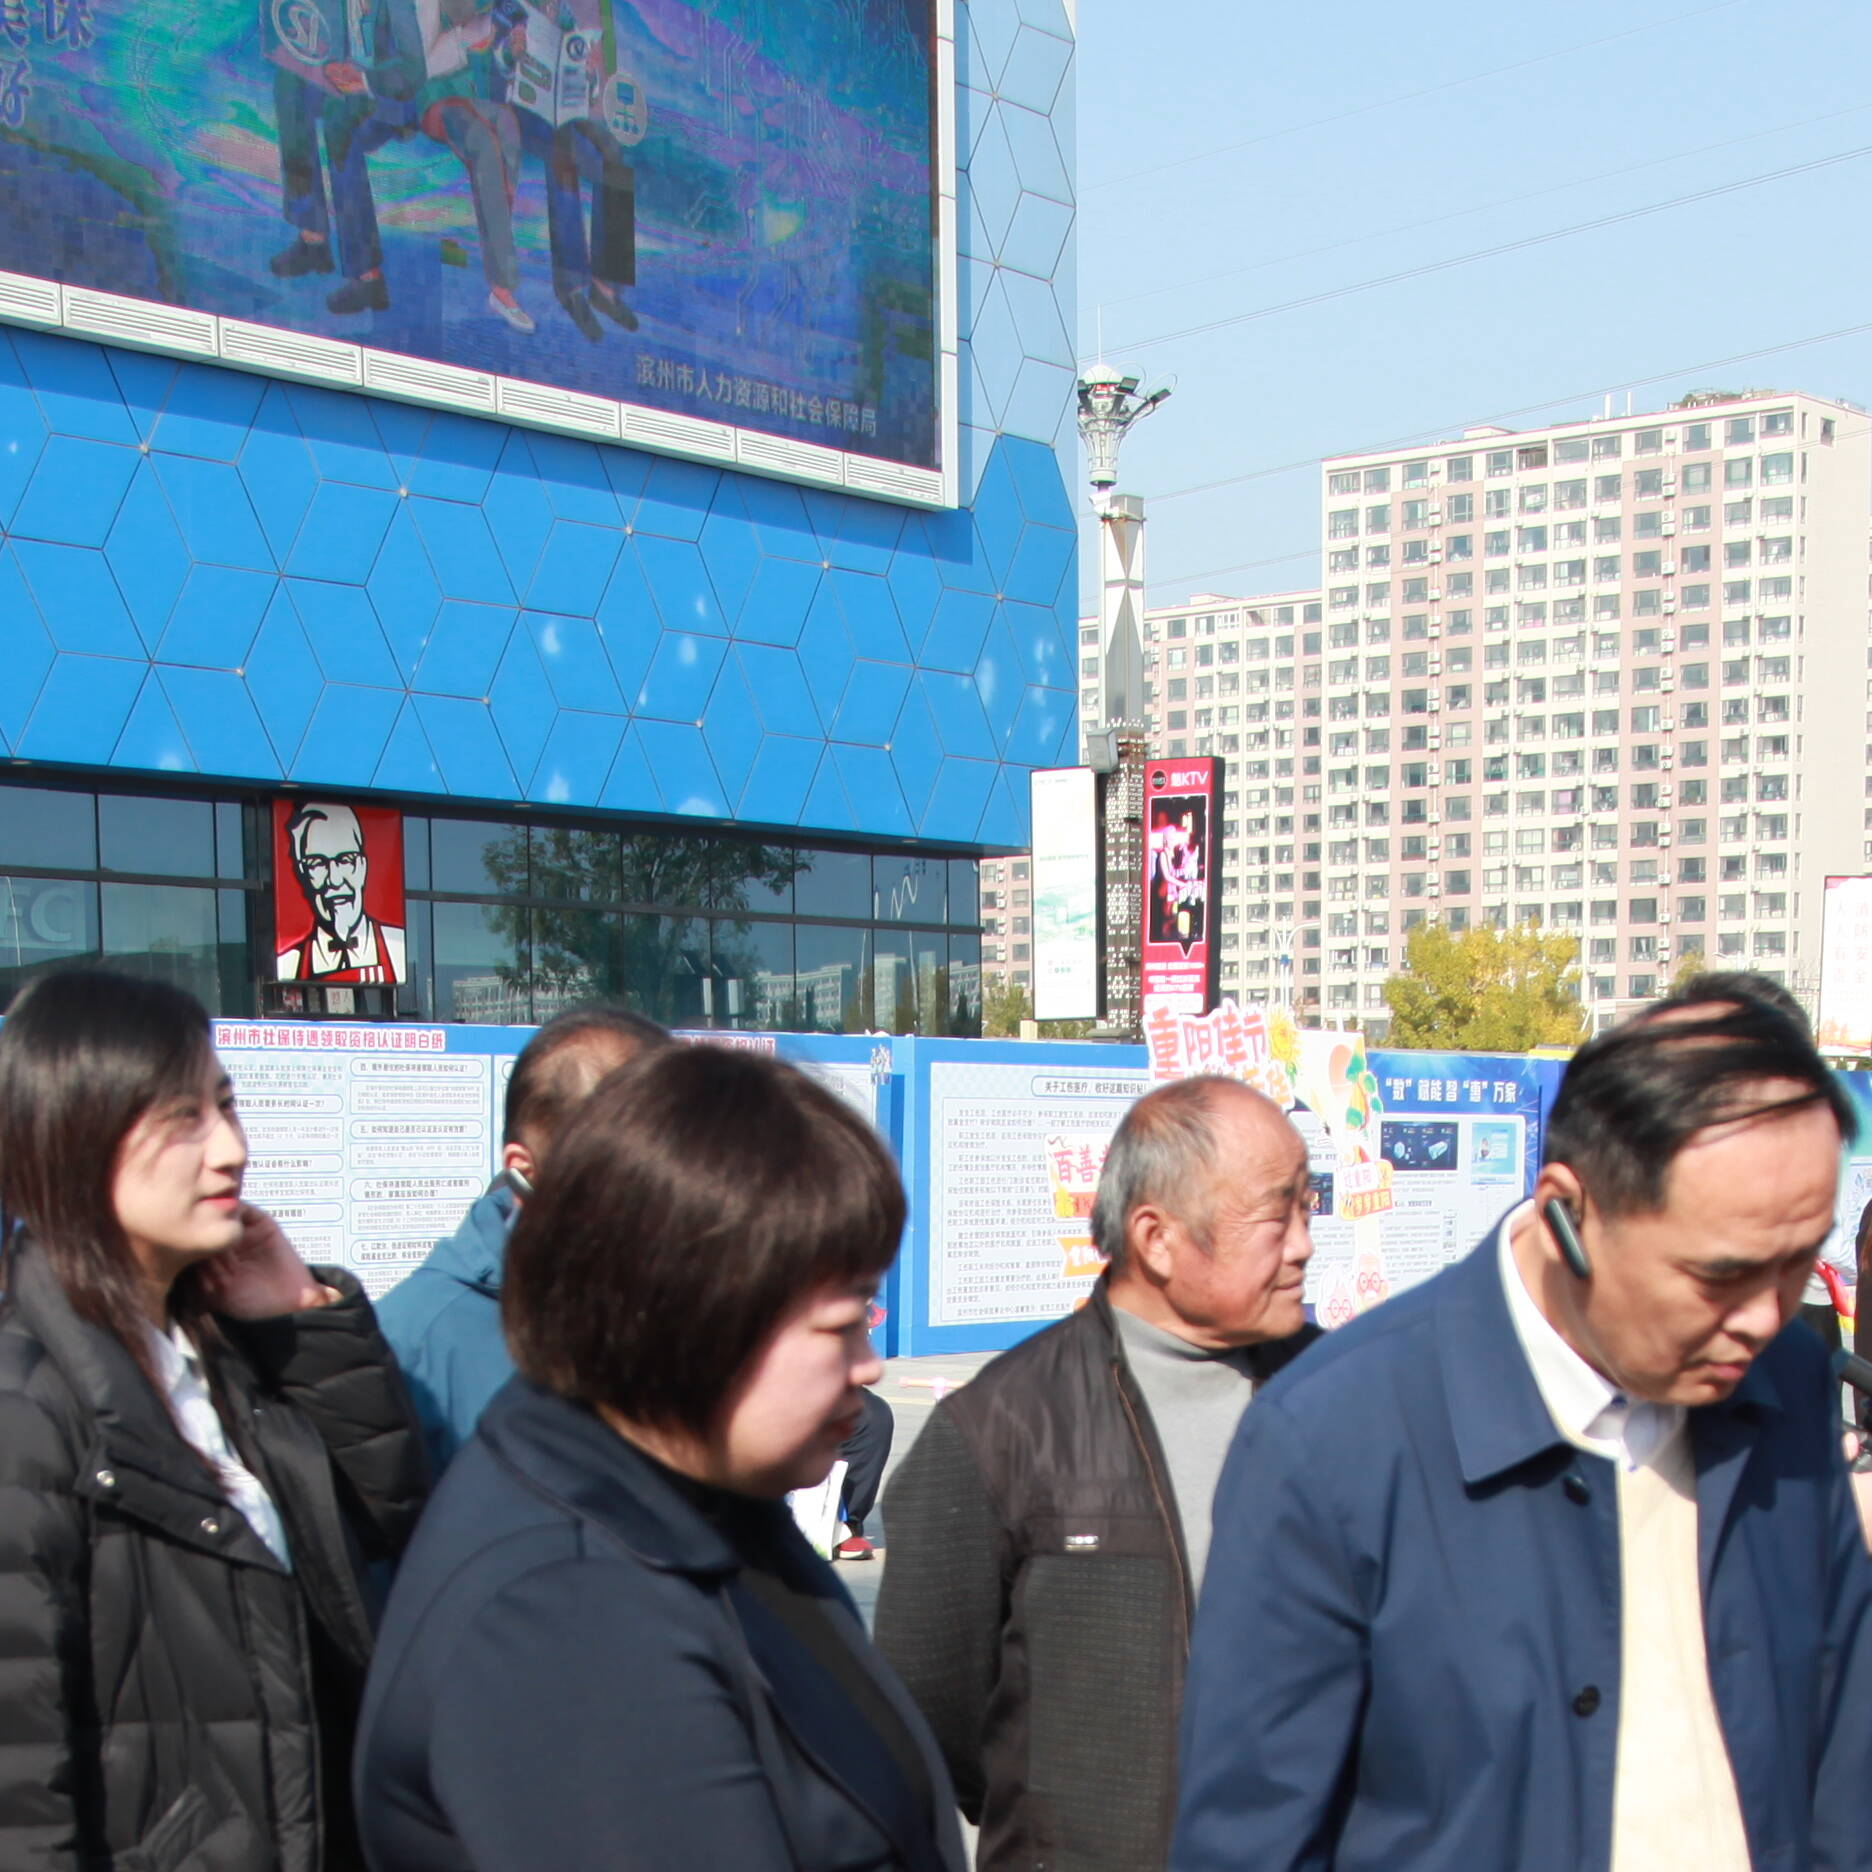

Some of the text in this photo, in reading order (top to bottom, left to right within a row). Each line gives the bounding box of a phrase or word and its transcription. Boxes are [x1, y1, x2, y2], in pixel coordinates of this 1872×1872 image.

[636, 356, 877, 437] 滨州市人力资源和社会保障局
[217, 1027, 444, 1050] 滨州市社保待遇领取资格认证明白纸
[1147, 1005, 1266, 1080] 重阳佳节
